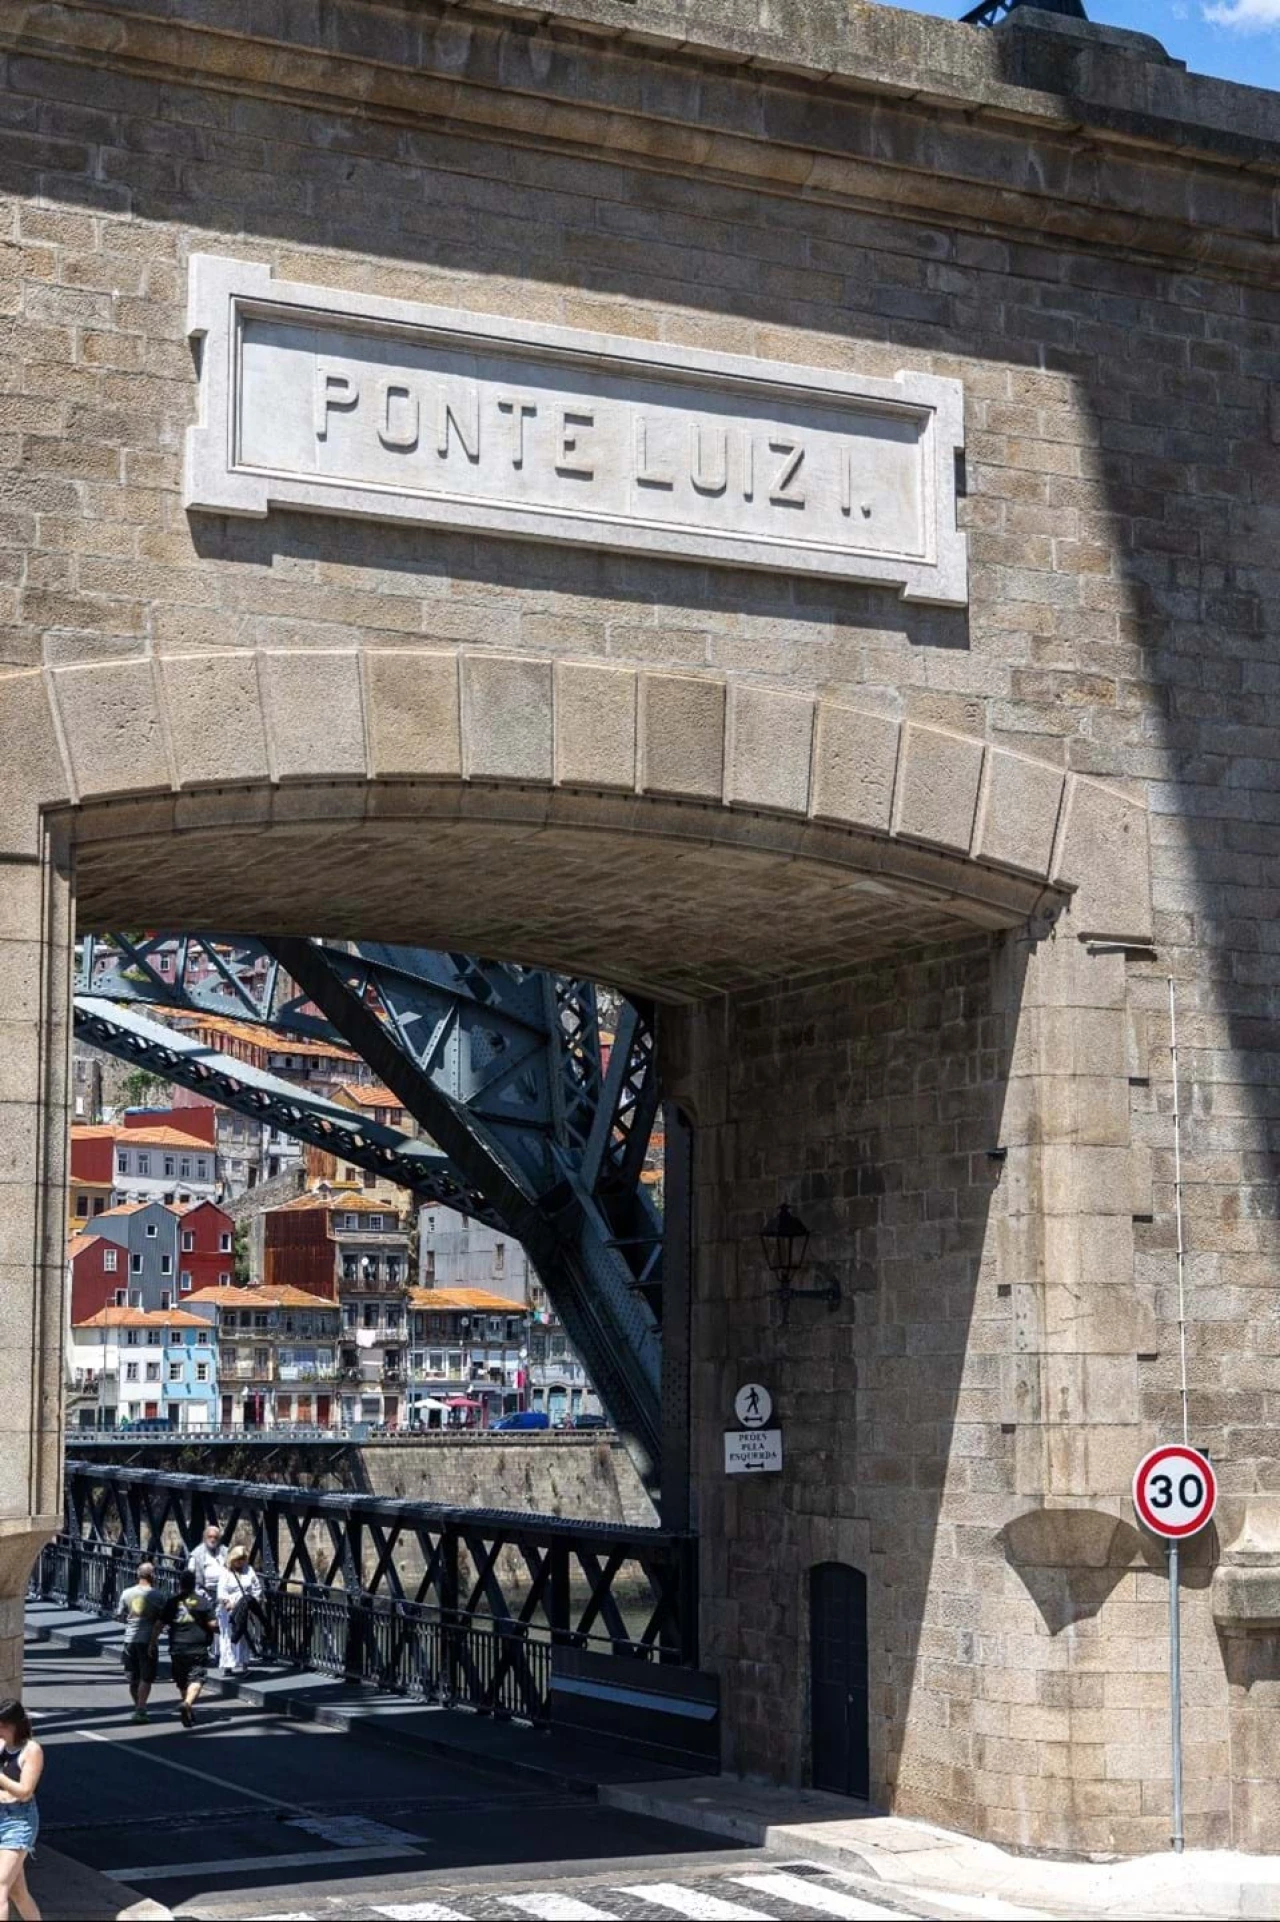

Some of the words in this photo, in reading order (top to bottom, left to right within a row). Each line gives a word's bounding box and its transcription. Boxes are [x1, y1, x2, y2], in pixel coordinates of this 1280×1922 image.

[316, 369, 595, 481] PONTE
[634, 415, 805, 510] LUIZ
[1150, 1474, 1203, 1508] 30
